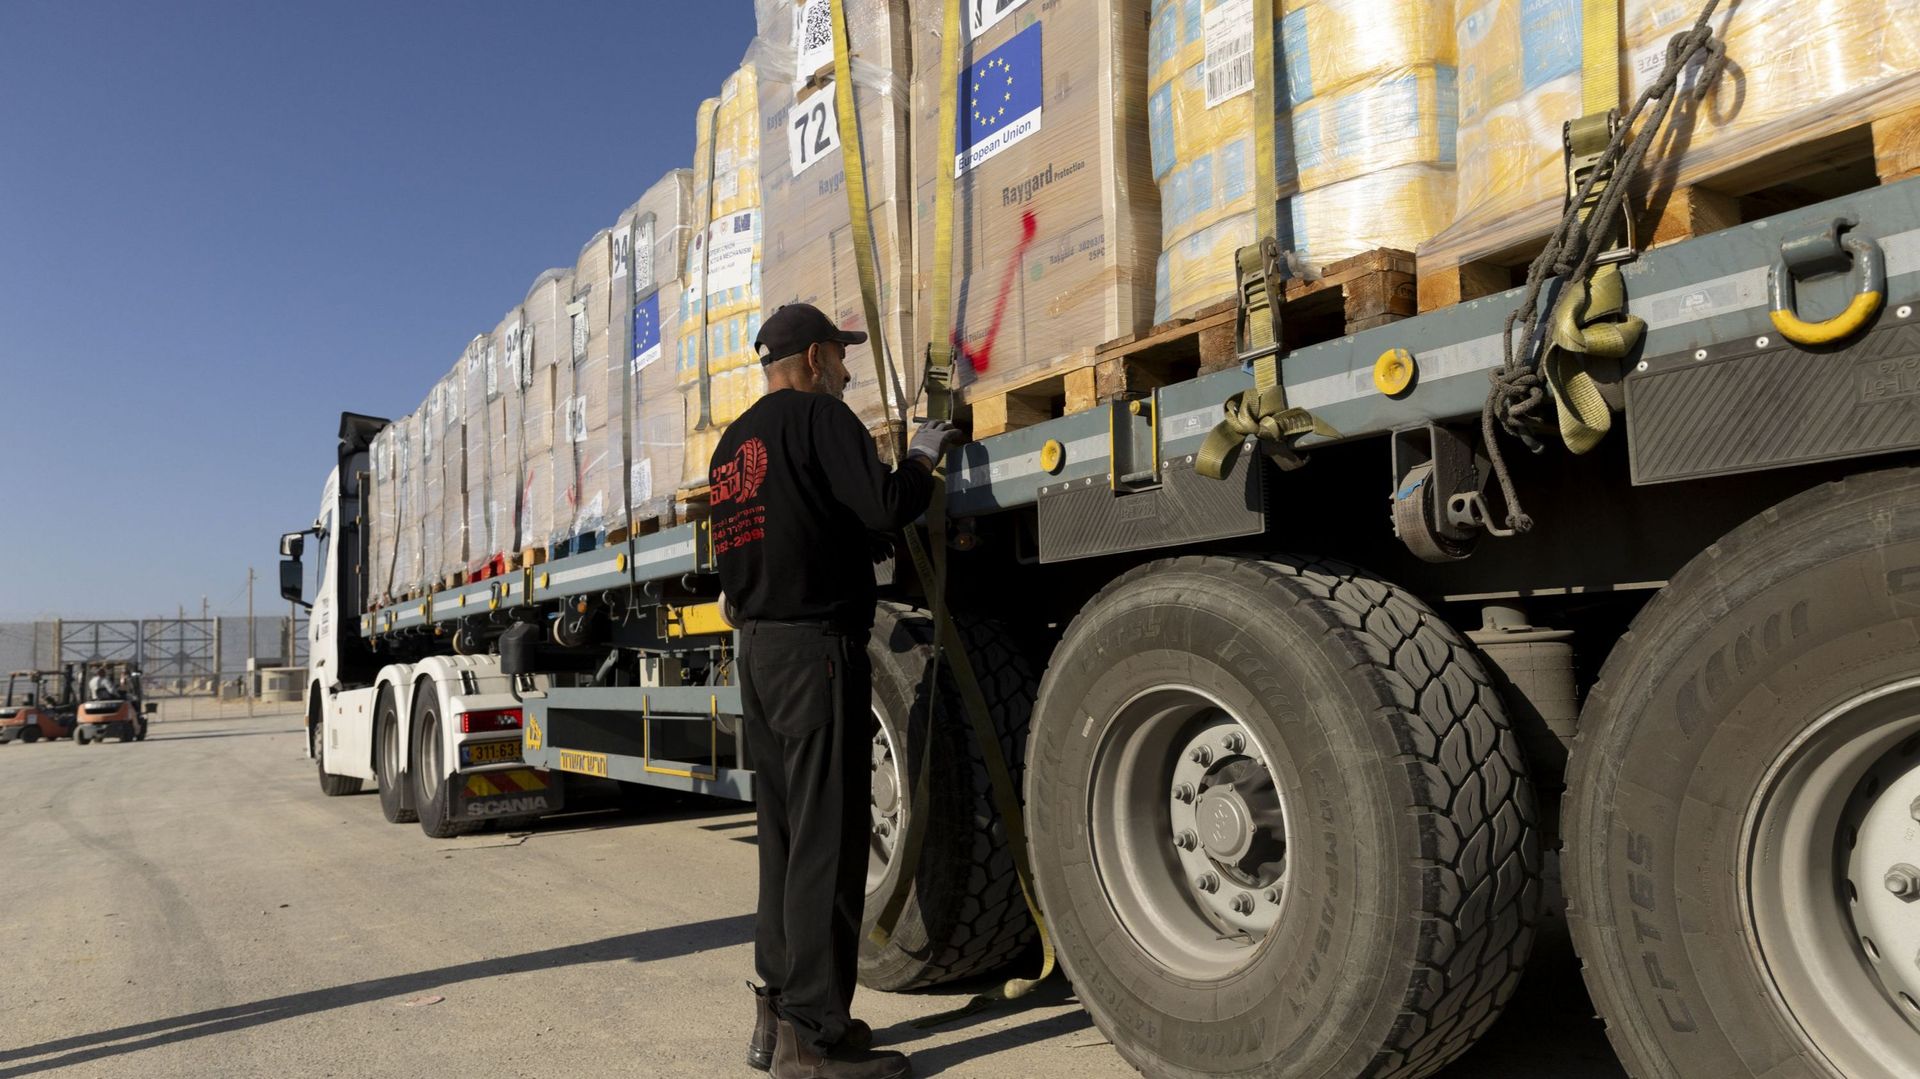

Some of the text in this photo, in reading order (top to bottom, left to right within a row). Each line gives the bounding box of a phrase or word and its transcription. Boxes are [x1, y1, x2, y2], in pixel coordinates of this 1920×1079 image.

[795, 102, 831, 164] 72
[958, 120, 1031, 170] European Union
[1002, 161, 1085, 207] Raygard Protection
[467, 796, 548, 817] SCANIA
